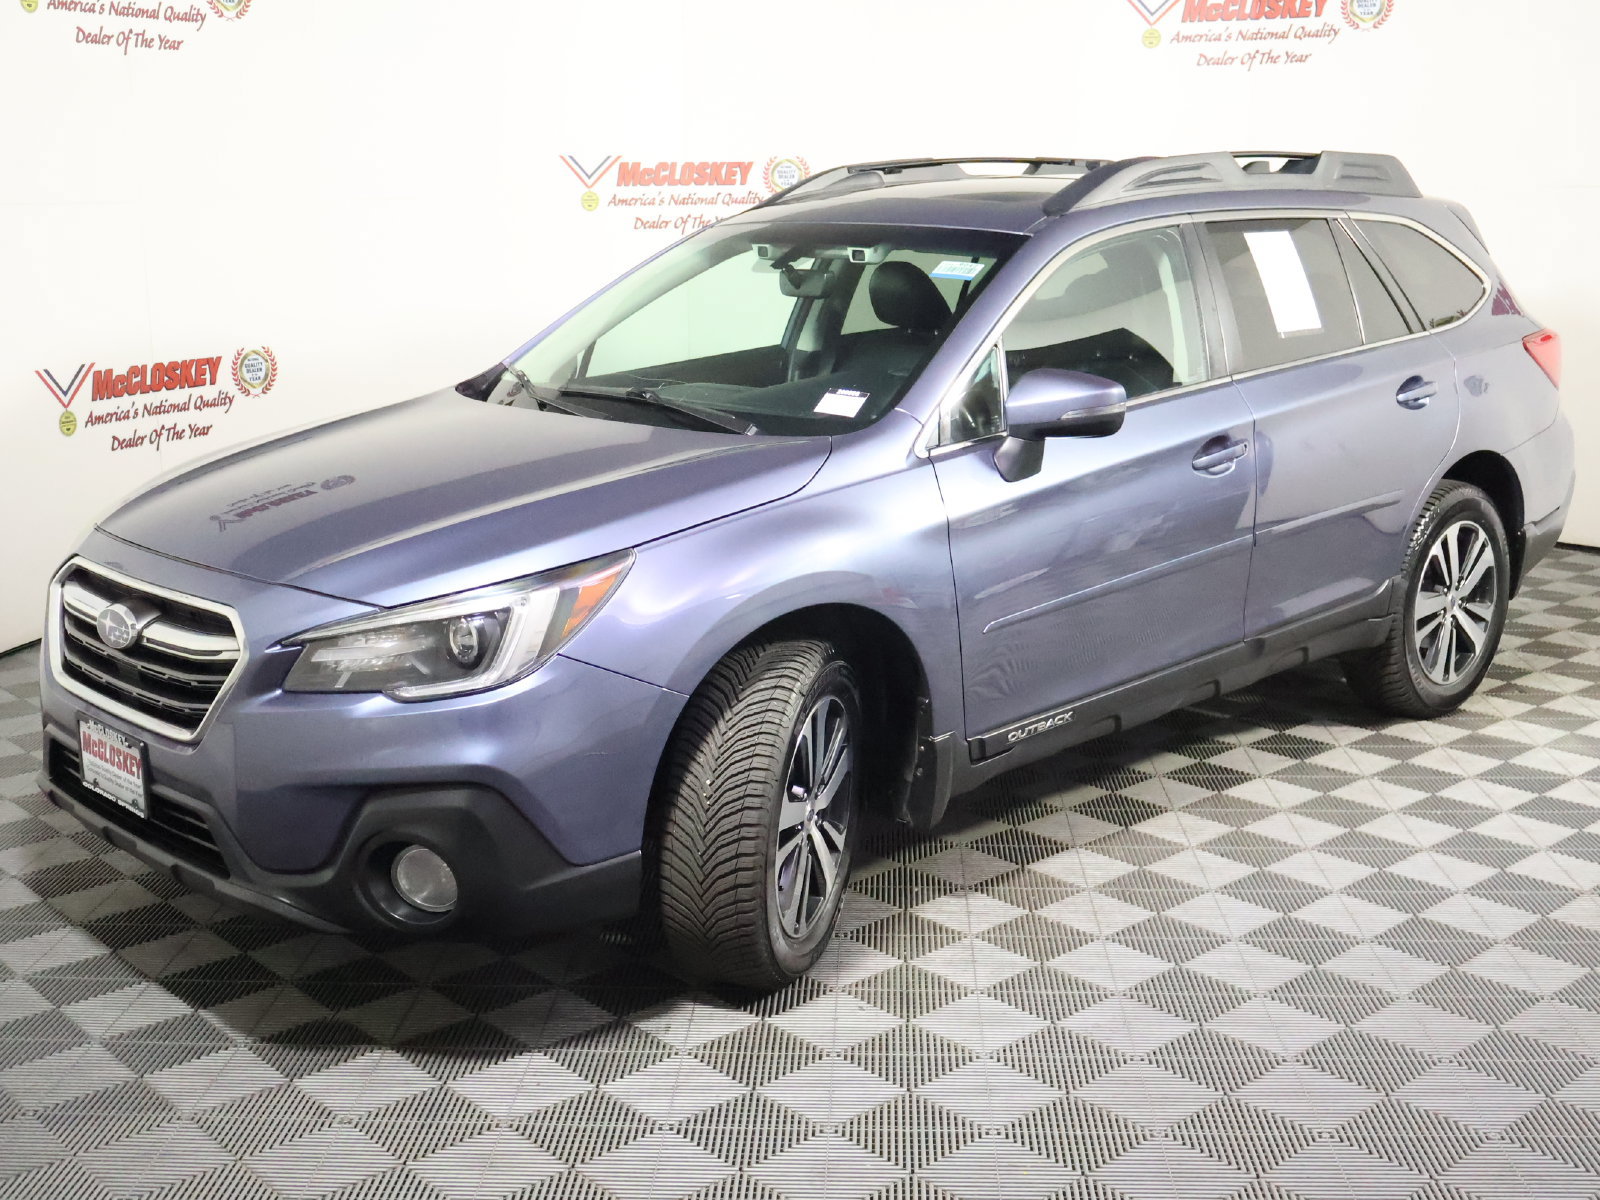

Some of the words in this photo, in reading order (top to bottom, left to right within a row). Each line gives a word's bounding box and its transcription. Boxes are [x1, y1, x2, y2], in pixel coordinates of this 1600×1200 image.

[108, 0, 159, 20] National
[163, 5, 206, 32] Quality
[1181, 0, 1328, 23] McCLOSKEY
[75, 26, 114, 46] Dealer
[116, 28, 133, 56] Of
[134, 30, 154, 49] The
[158, 34, 184, 51] Year
[1170, 26, 1232, 44] America's
[1236, 24, 1292, 42] National
[1294, 22, 1341, 45] Quality
[1197, 52, 1238, 67] Dealer
[1240, 50, 1259, 71] Of
[1258, 50, 1280, 65] The
[1285, 50, 1312, 64] Year
[616, 161, 754, 187] McCLOSKEY
[607, 191, 665, 207] America's
[668, 191, 721, 206] National
[633, 214, 672, 230] Dealer
[673, 213, 692, 235] Of
[691, 213, 712, 230] The
[91, 355, 223, 402] McCLOSKEY
[84, 401, 139, 428] America's
[142, 393, 190, 417] National
[193, 389, 235, 414] Quality
[110, 428, 148, 451] Dealer
[149, 424, 166, 451] Of
[164, 422, 185, 443] The
[187, 421, 213, 439] Year
[1007, 711, 1074, 742] OUTBACK
[82, 731, 142, 780] McCLOSKEY
